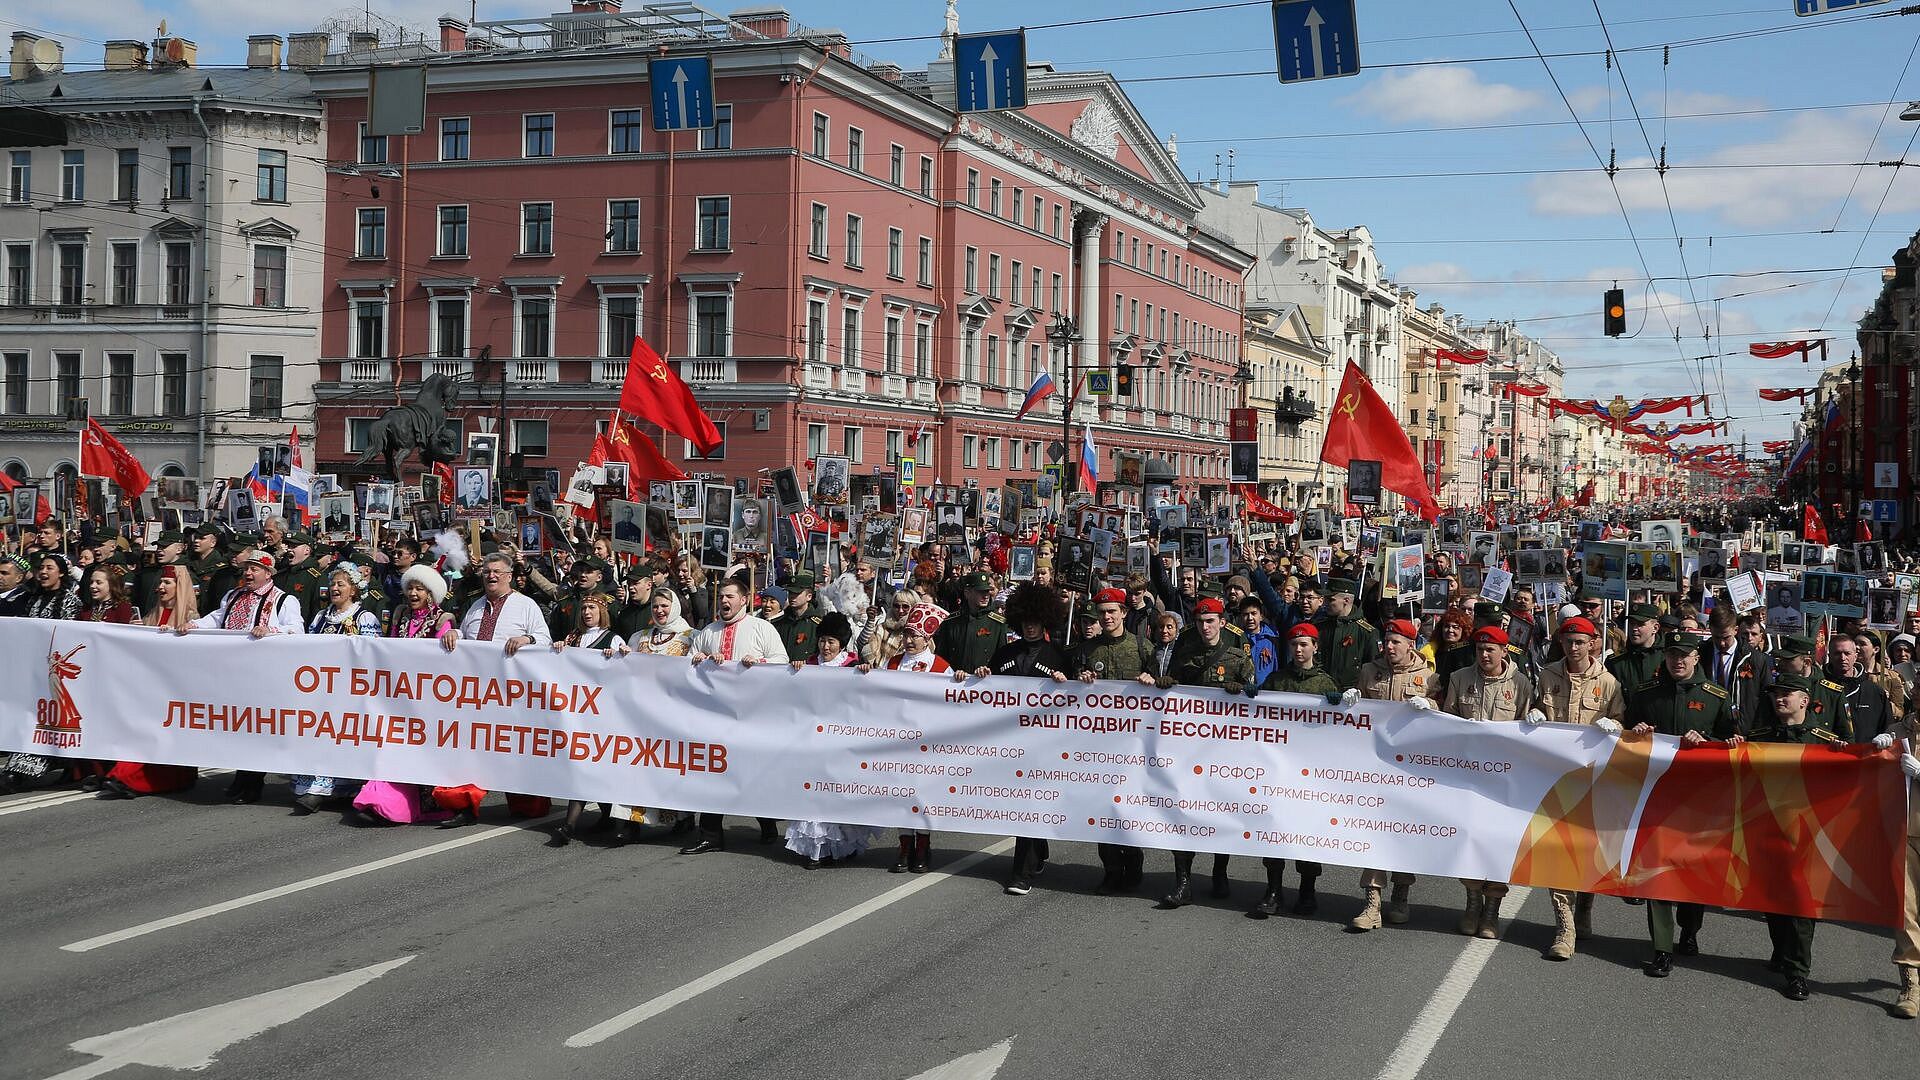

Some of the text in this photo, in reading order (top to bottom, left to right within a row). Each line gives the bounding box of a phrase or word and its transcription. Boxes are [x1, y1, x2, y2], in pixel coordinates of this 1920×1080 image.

[150, 421, 174, 431] ФУД
[294, 665, 603, 715] ОТ БЛАГОДАРНЫХ
[36, 698, 59, 727] 80
[945, 688, 1372, 731] НАРОДЫ СССР, ОСВОБОДИВШИЕ ЛЕНИНГРАД
[33, 729, 81, 748] ПОБЕДА!
[163, 700, 728, 776] ЛЕНИНГРАДЦЕВ И ПЕТЕРБУРЖЦЕВ
[827, 724, 923, 741] ГРУЗИНСКАЯ ССР
[1019, 714, 1060, 728] ВАШ
[1066, 715, 1142, 735] ПОДВИГ
[1160, 721, 1288, 744] БЕССМЕРТЕН
[931, 743, 1025, 759] КАЗАХСКАЯ ССР
[1073, 751, 1174, 768] ЭСТОНСКАЯ ССР
[872, 761, 972, 778] КИРГИЗСКАЯ ССР
[1210, 765, 1265, 780] РСФСР
[1408, 753, 1512, 774] УЗБЕКСКАЯ ССР
[1026, 769, 1127, 785] АРМЯНСКАЯ ССР
[1314, 768, 1435, 789] МОЛДАВСКАЯ ССР
[814, 780, 916, 798] ЛАТВИЙСКАЯ ССР
[960, 785, 1060, 801] ЛИТОВСКАЯ ССР
[1261, 786, 1385, 807] ТУРКМЕНСКАЯ ССР
[922, 805, 1068, 825] АЗЕРБАЙДЖАНСКАЯ ССР
[1126, 794, 1269, 815] КАРЕЛО-ФИНСКАЯ ССР
[1099, 816, 1217, 837] БЕЛОРУССКАЯ ССР
[1344, 817, 1457, 838] УКРАИНСКАЯ ССР
[1255, 830, 1371, 853] ТАДЖИКСКАЯ ССР
